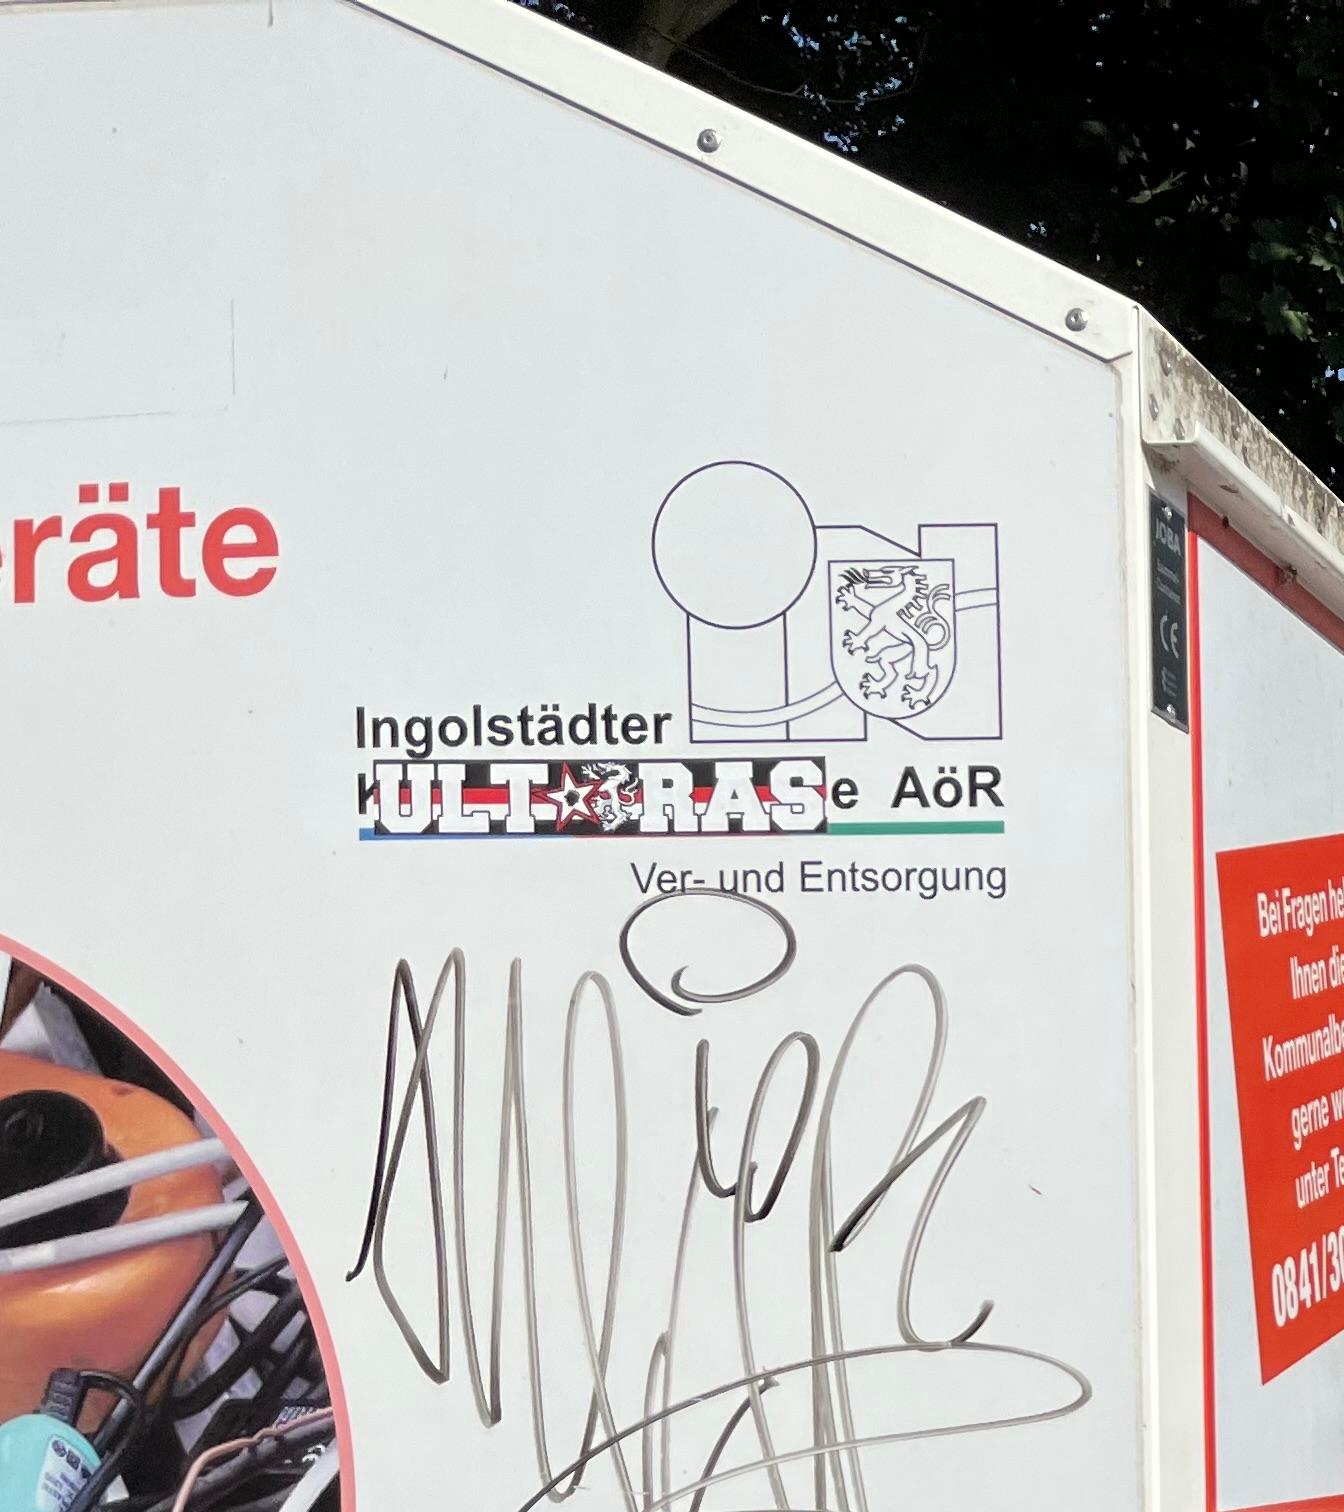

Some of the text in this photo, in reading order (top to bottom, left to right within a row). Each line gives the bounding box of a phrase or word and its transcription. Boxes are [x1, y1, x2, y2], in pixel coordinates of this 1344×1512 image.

[0, 482, 279, 604] räte
[356, 703, 673, 758] Ingolstädter
[892, 765, 1004, 809] AöR
[631, 860, 1008, 899] Ver- und Entsorgung
[1257, 889, 1282, 937] Bei
[1282, 887, 1329, 937] Fragen
[1290, 955, 1328, 1000] Ihnen
[1291, 1095, 1330, 1151] gerne
[1295, 1161, 1330, 1209] unter
